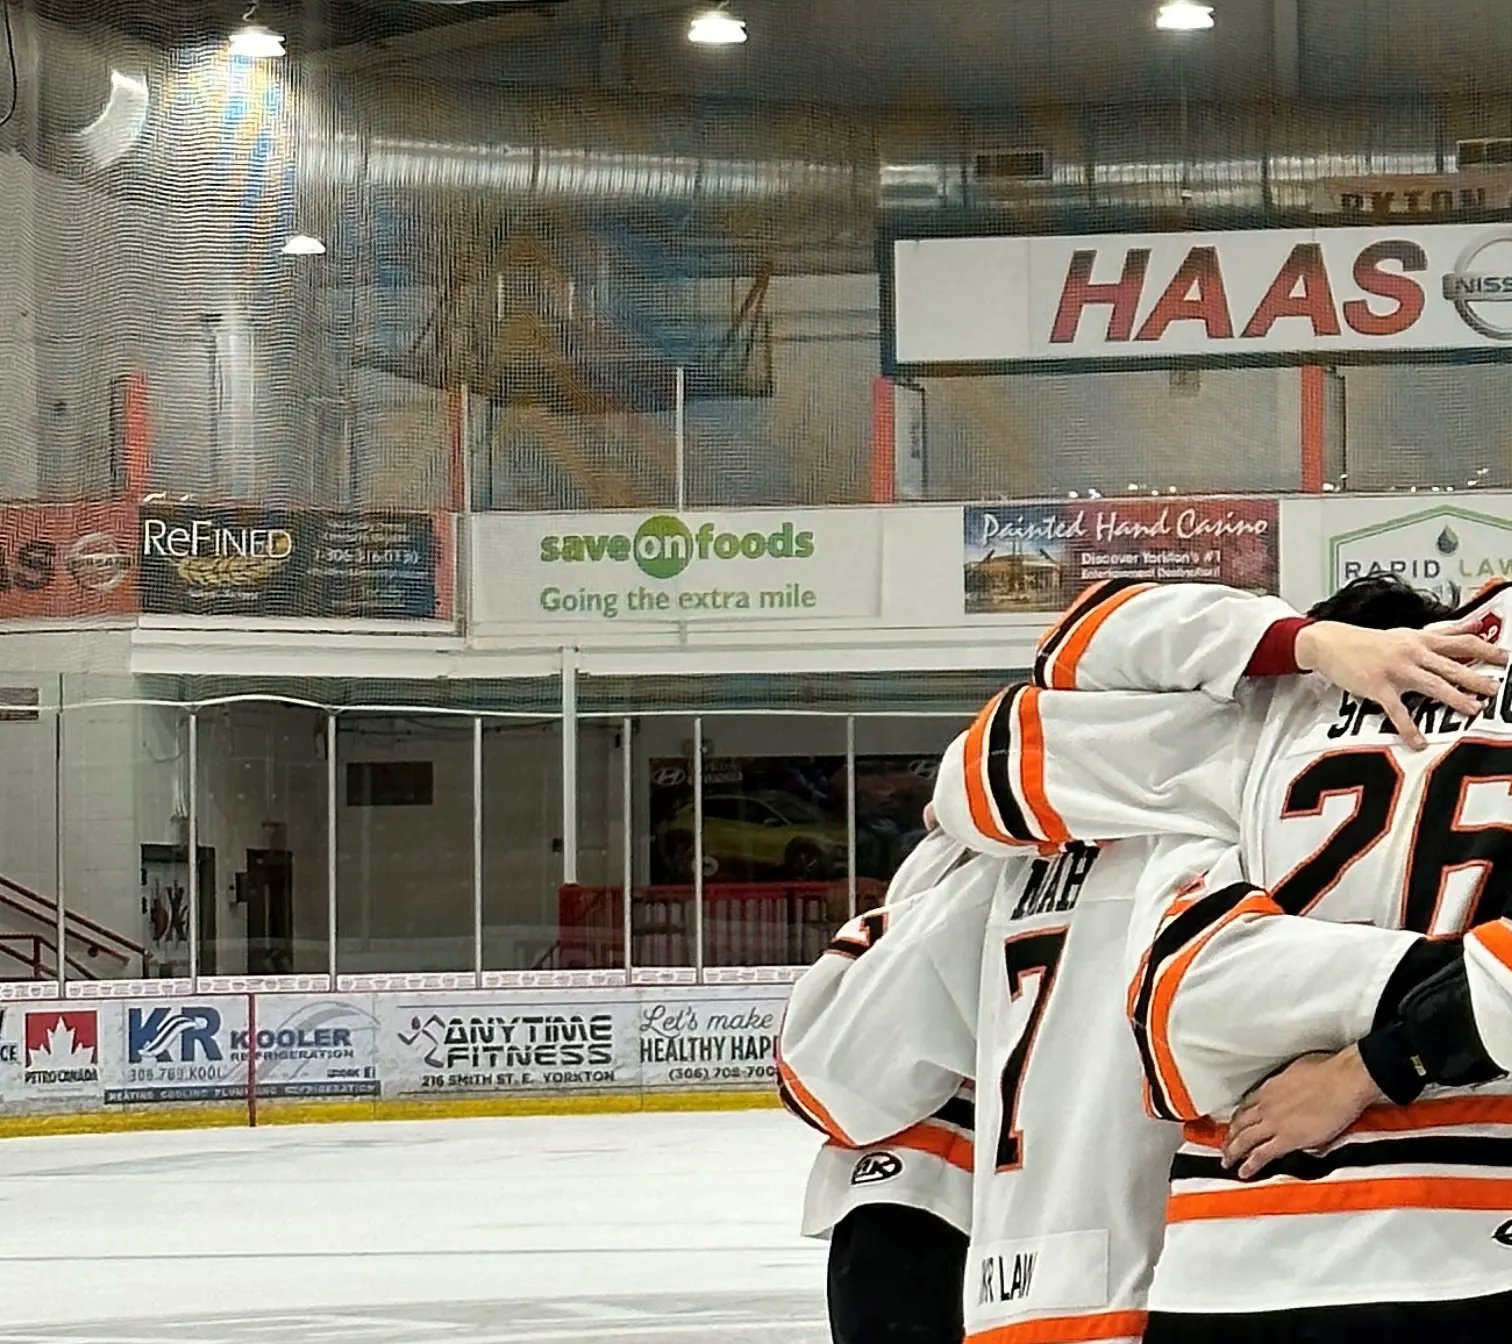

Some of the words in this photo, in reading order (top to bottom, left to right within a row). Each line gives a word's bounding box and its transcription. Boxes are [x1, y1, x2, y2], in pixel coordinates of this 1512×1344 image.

[1050, 239, 1428, 343] HAAS
[974, 510, 1089, 545] Painted
[1096, 507, 1172, 541] Hand
[1176, 508, 1269, 540] Casino
[1081, 552, 1139, 565] Discover
[1344, 559, 1442, 579] RAPID
[540, 587, 618, 618] Going
[627, 585, 670, 610] the
[679, 587, 750, 610] extra
[759, 583, 817, 609] mile
[128, 1006, 223, 1064] KR
[444, 1014, 613, 1044] ANYTIME
[640, 1004, 699, 1039] Let's
[707, 1006, 774, 1031] make
[447, 1043, 613, 1069] FITNESS
[640, 1035, 728, 1064] HEALTHY
[994, 925, 1070, 1175] 7
[214, 1085, 277, 1098] PLUMING
[421, 1074, 445, 1088] 216
[449, 1073, 493, 1087] SMITH
[543, 1070, 616, 1084] YORKTON
